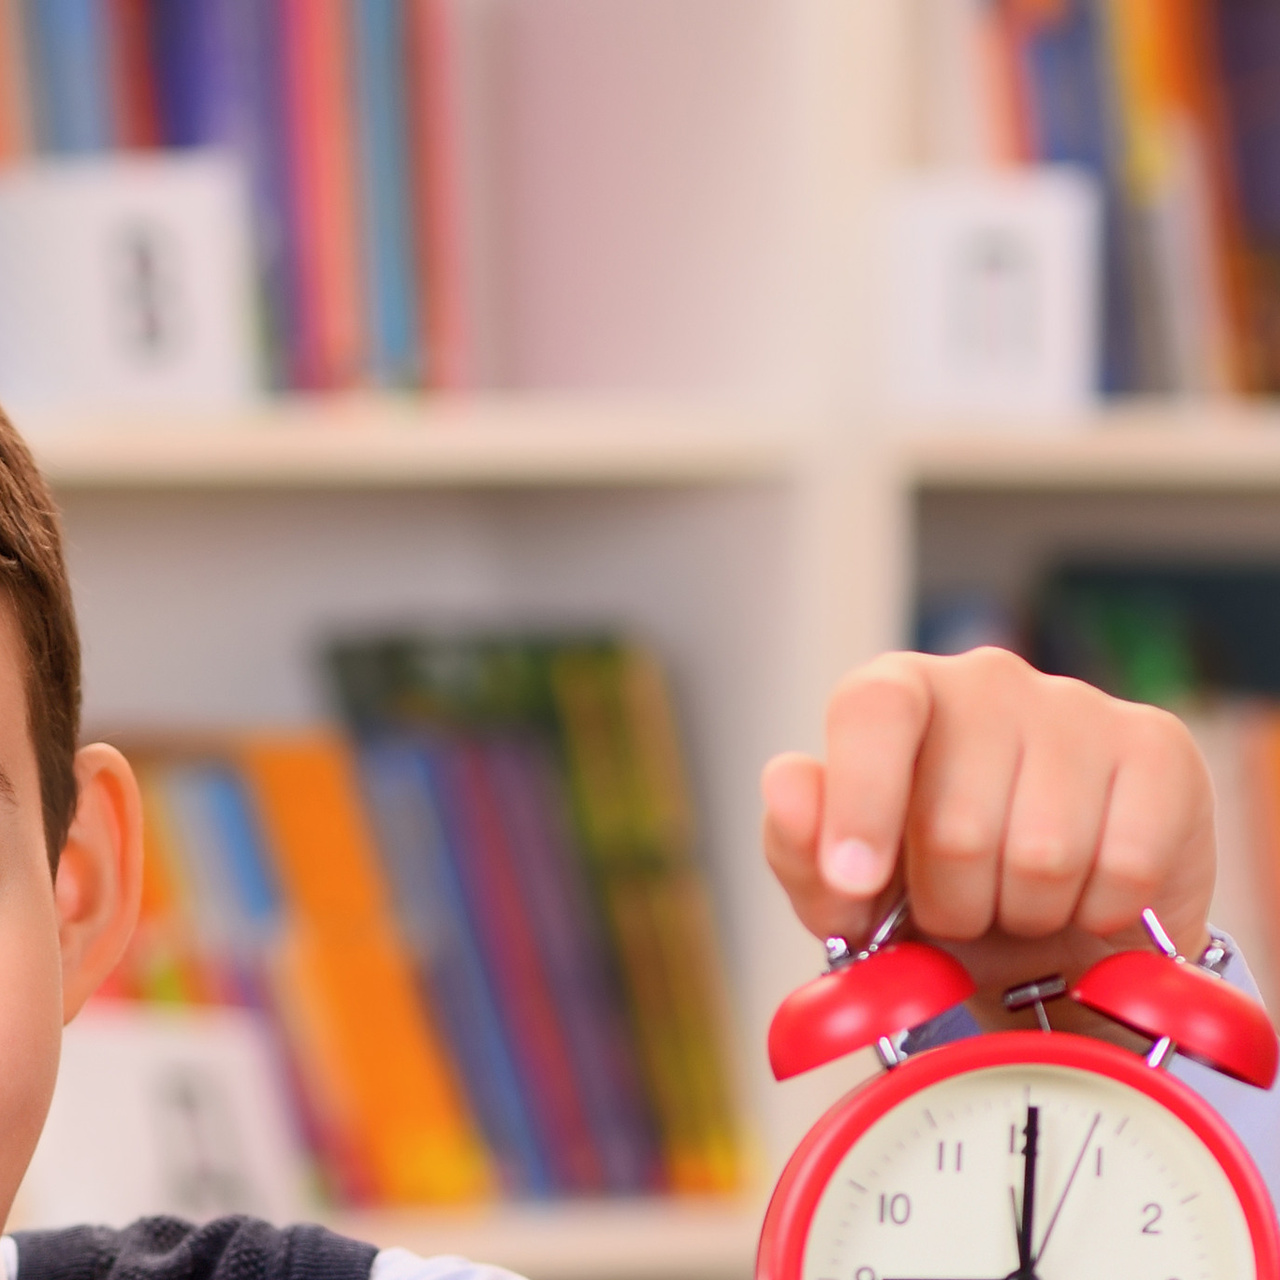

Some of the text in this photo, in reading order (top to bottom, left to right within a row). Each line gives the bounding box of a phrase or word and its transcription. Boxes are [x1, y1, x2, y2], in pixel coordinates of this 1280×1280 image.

[936, 1140, 963, 1173] 11
[1095, 1147, 1103, 1178] 1
[878, 1192, 912, 1226] 10
[1141, 1202, 1163, 1235] 2
